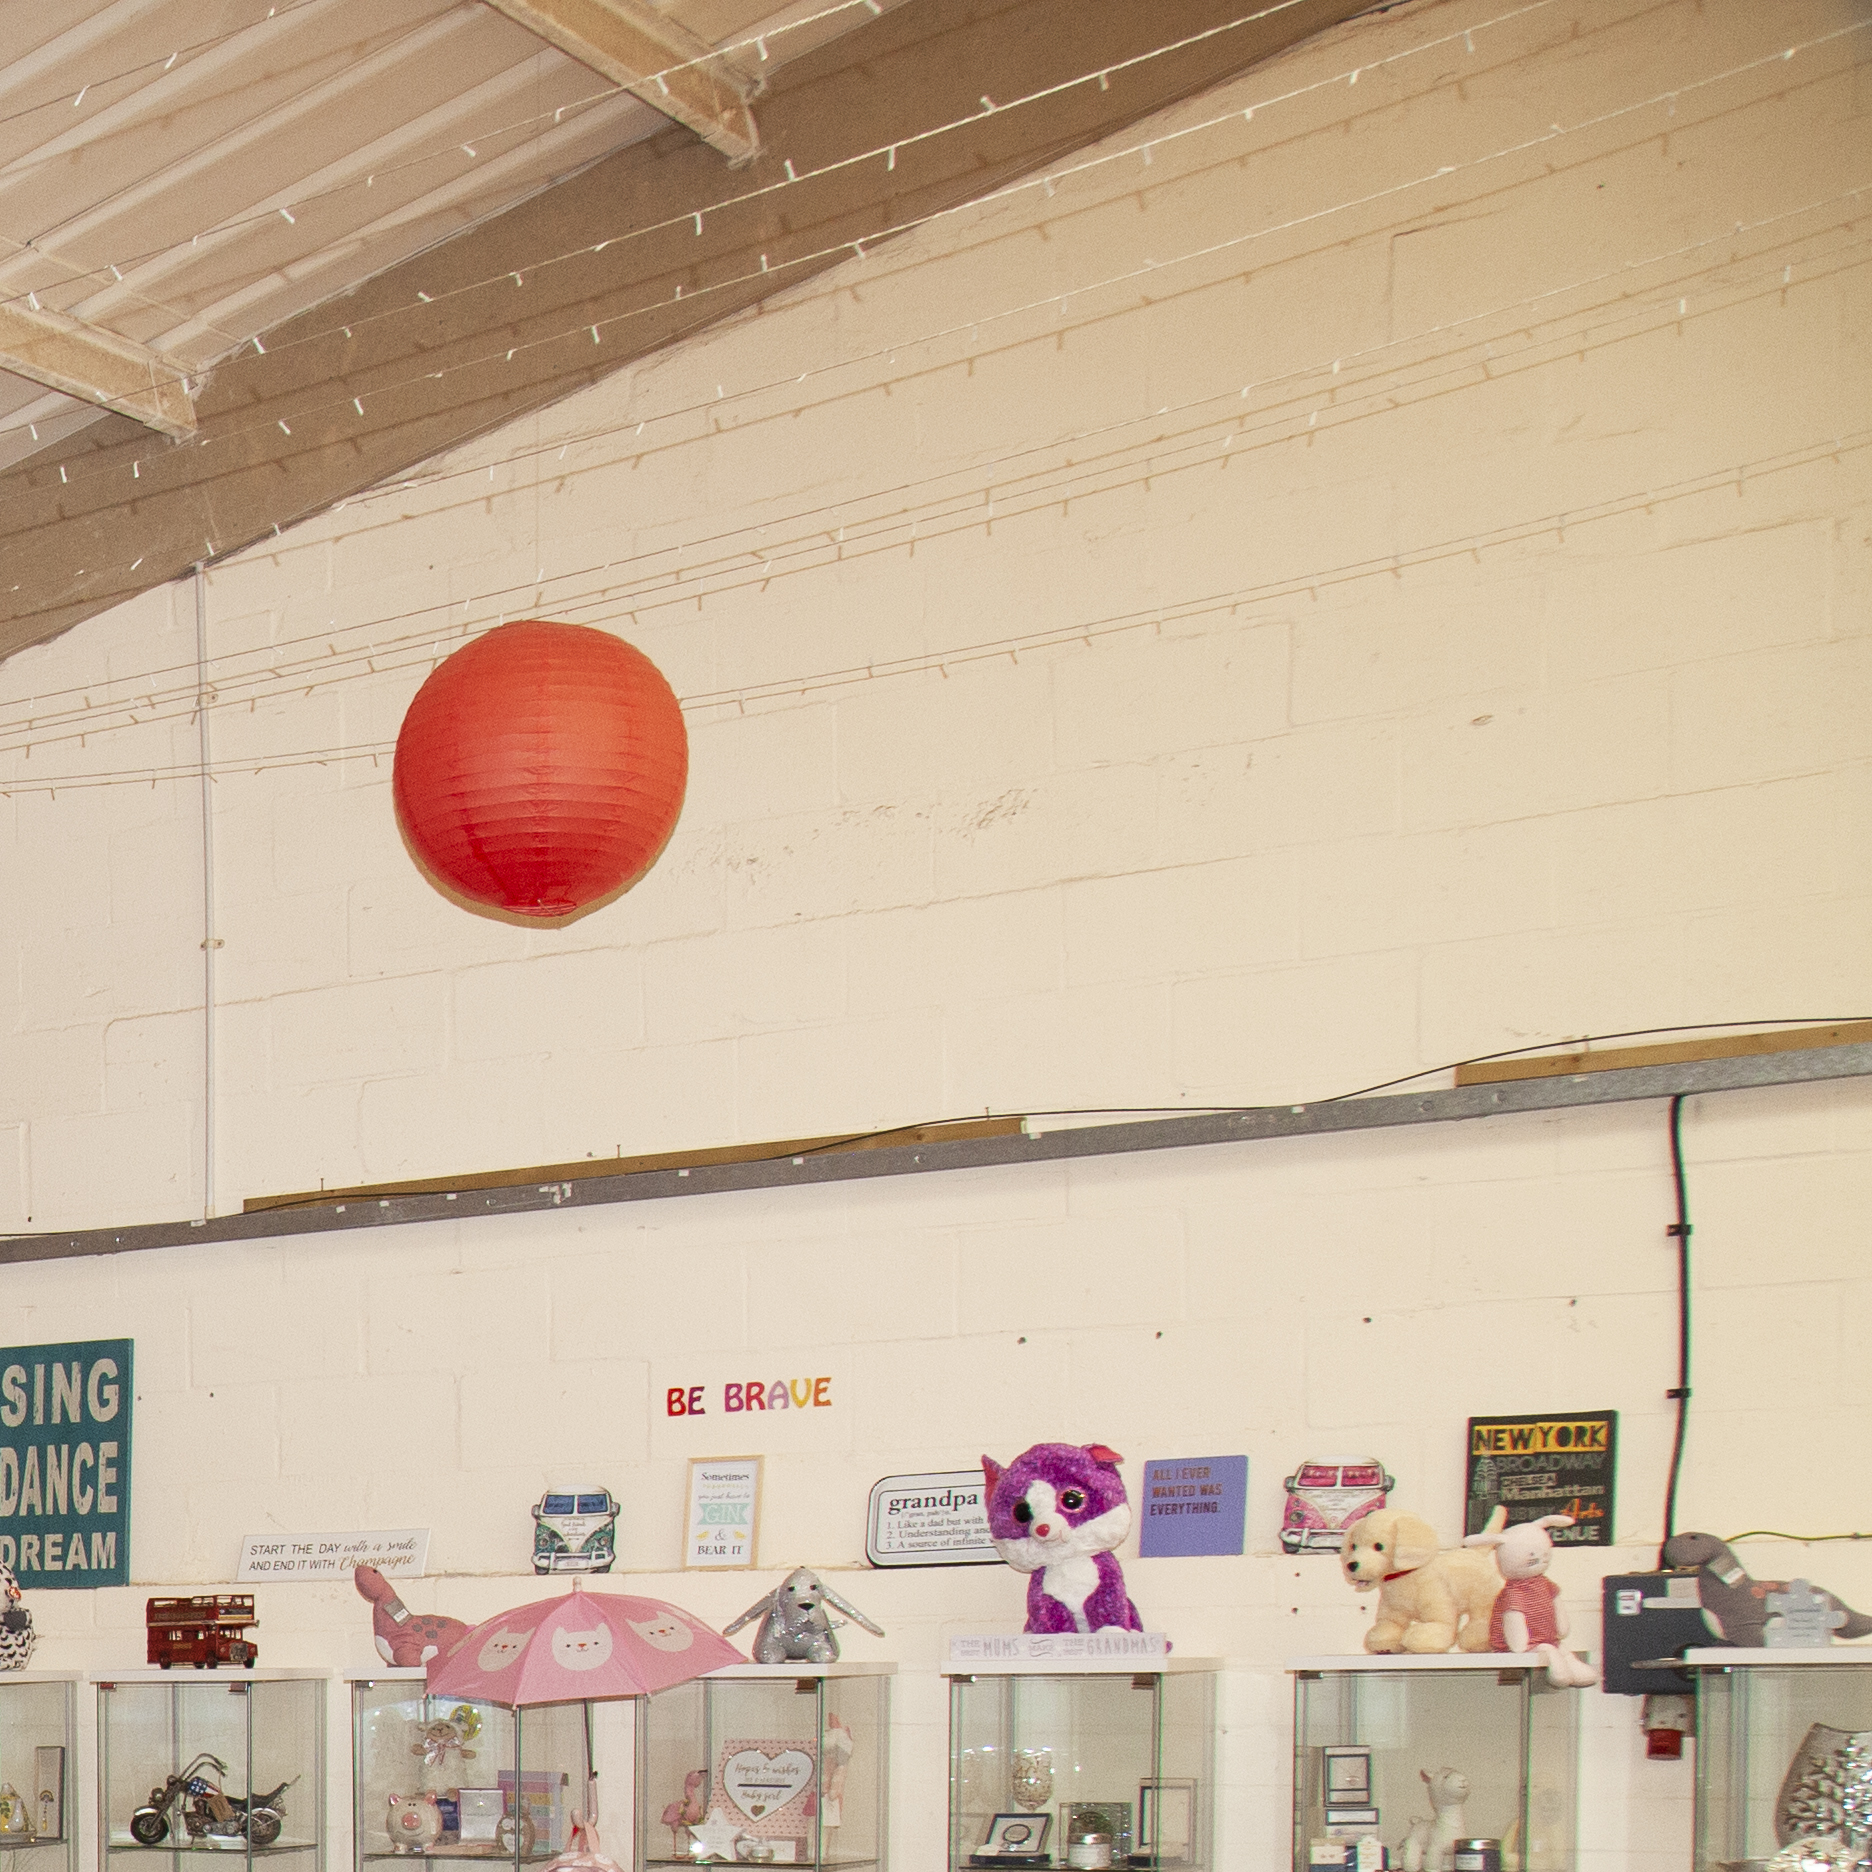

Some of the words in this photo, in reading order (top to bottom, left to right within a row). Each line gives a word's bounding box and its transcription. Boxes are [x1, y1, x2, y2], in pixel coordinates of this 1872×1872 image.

[0, 1357, 120, 1428] SING
[667, 1385, 706, 1417] BE
[724, 1376, 833, 1413] BRAVE
[1473, 1426, 1535, 1451] NEW
[1537, 1424, 1606, 1449] YORK
[700, 1472, 750, 1482] Sometimes
[1152, 1467, 1173, 1481] ALL
[1151, 1484, 1196, 1498] WANTED
[1199, 1483, 1223, 1496] WAS
[888, 1489, 979, 1515] grandpa
[705, 1504, 743, 1524] GIN
[897, 1520, 918, 1530] Like
[927, 1518, 944, 1528] dad
[946, 1517, 962, 1526] but
[963, 1516, 985, 1525] with
[898, 1526, 971, 1540] Understanding
[250, 1543, 286, 1556] START
[291, 1543, 314, 1555] THE
[318, 1542, 342, 1555] DAY
[696, 1544, 728, 1556] BEAR
[730, 1544, 744, 1556] IT
[907, 1539, 938, 1548] source
[249, 1560, 272, 1572] AND
[272, 1559, 295, 1571] END
[297, 1559, 307, 1571] IT
[309, 1558, 336, 1571] WITH
